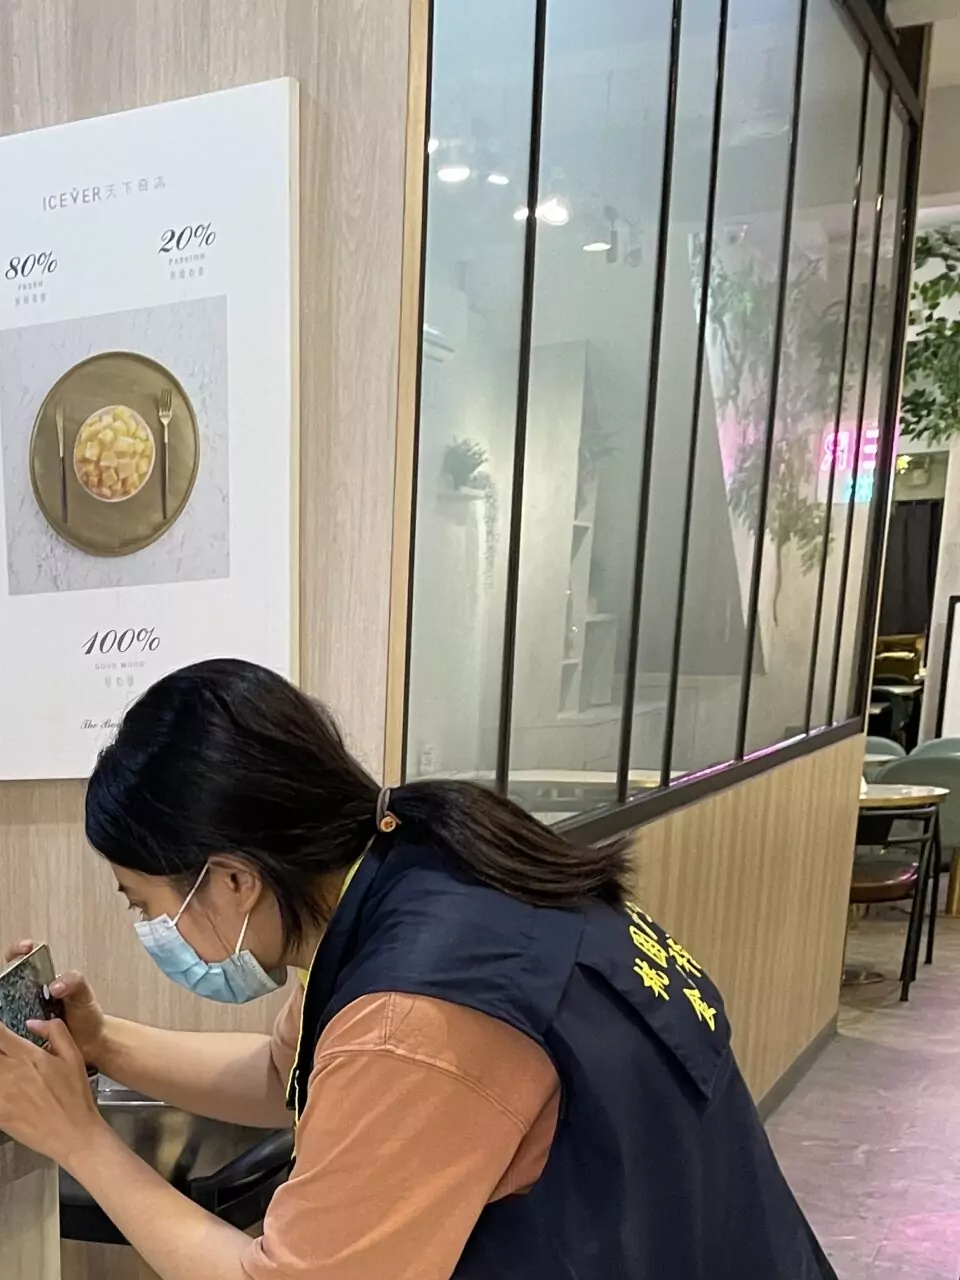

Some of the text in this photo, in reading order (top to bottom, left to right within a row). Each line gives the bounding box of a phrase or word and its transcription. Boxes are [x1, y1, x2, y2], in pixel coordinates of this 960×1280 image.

[158, 222, 216, 254] 20%
[5, 250, 58, 280] 80%
[81, 626, 161, 655] 100%
